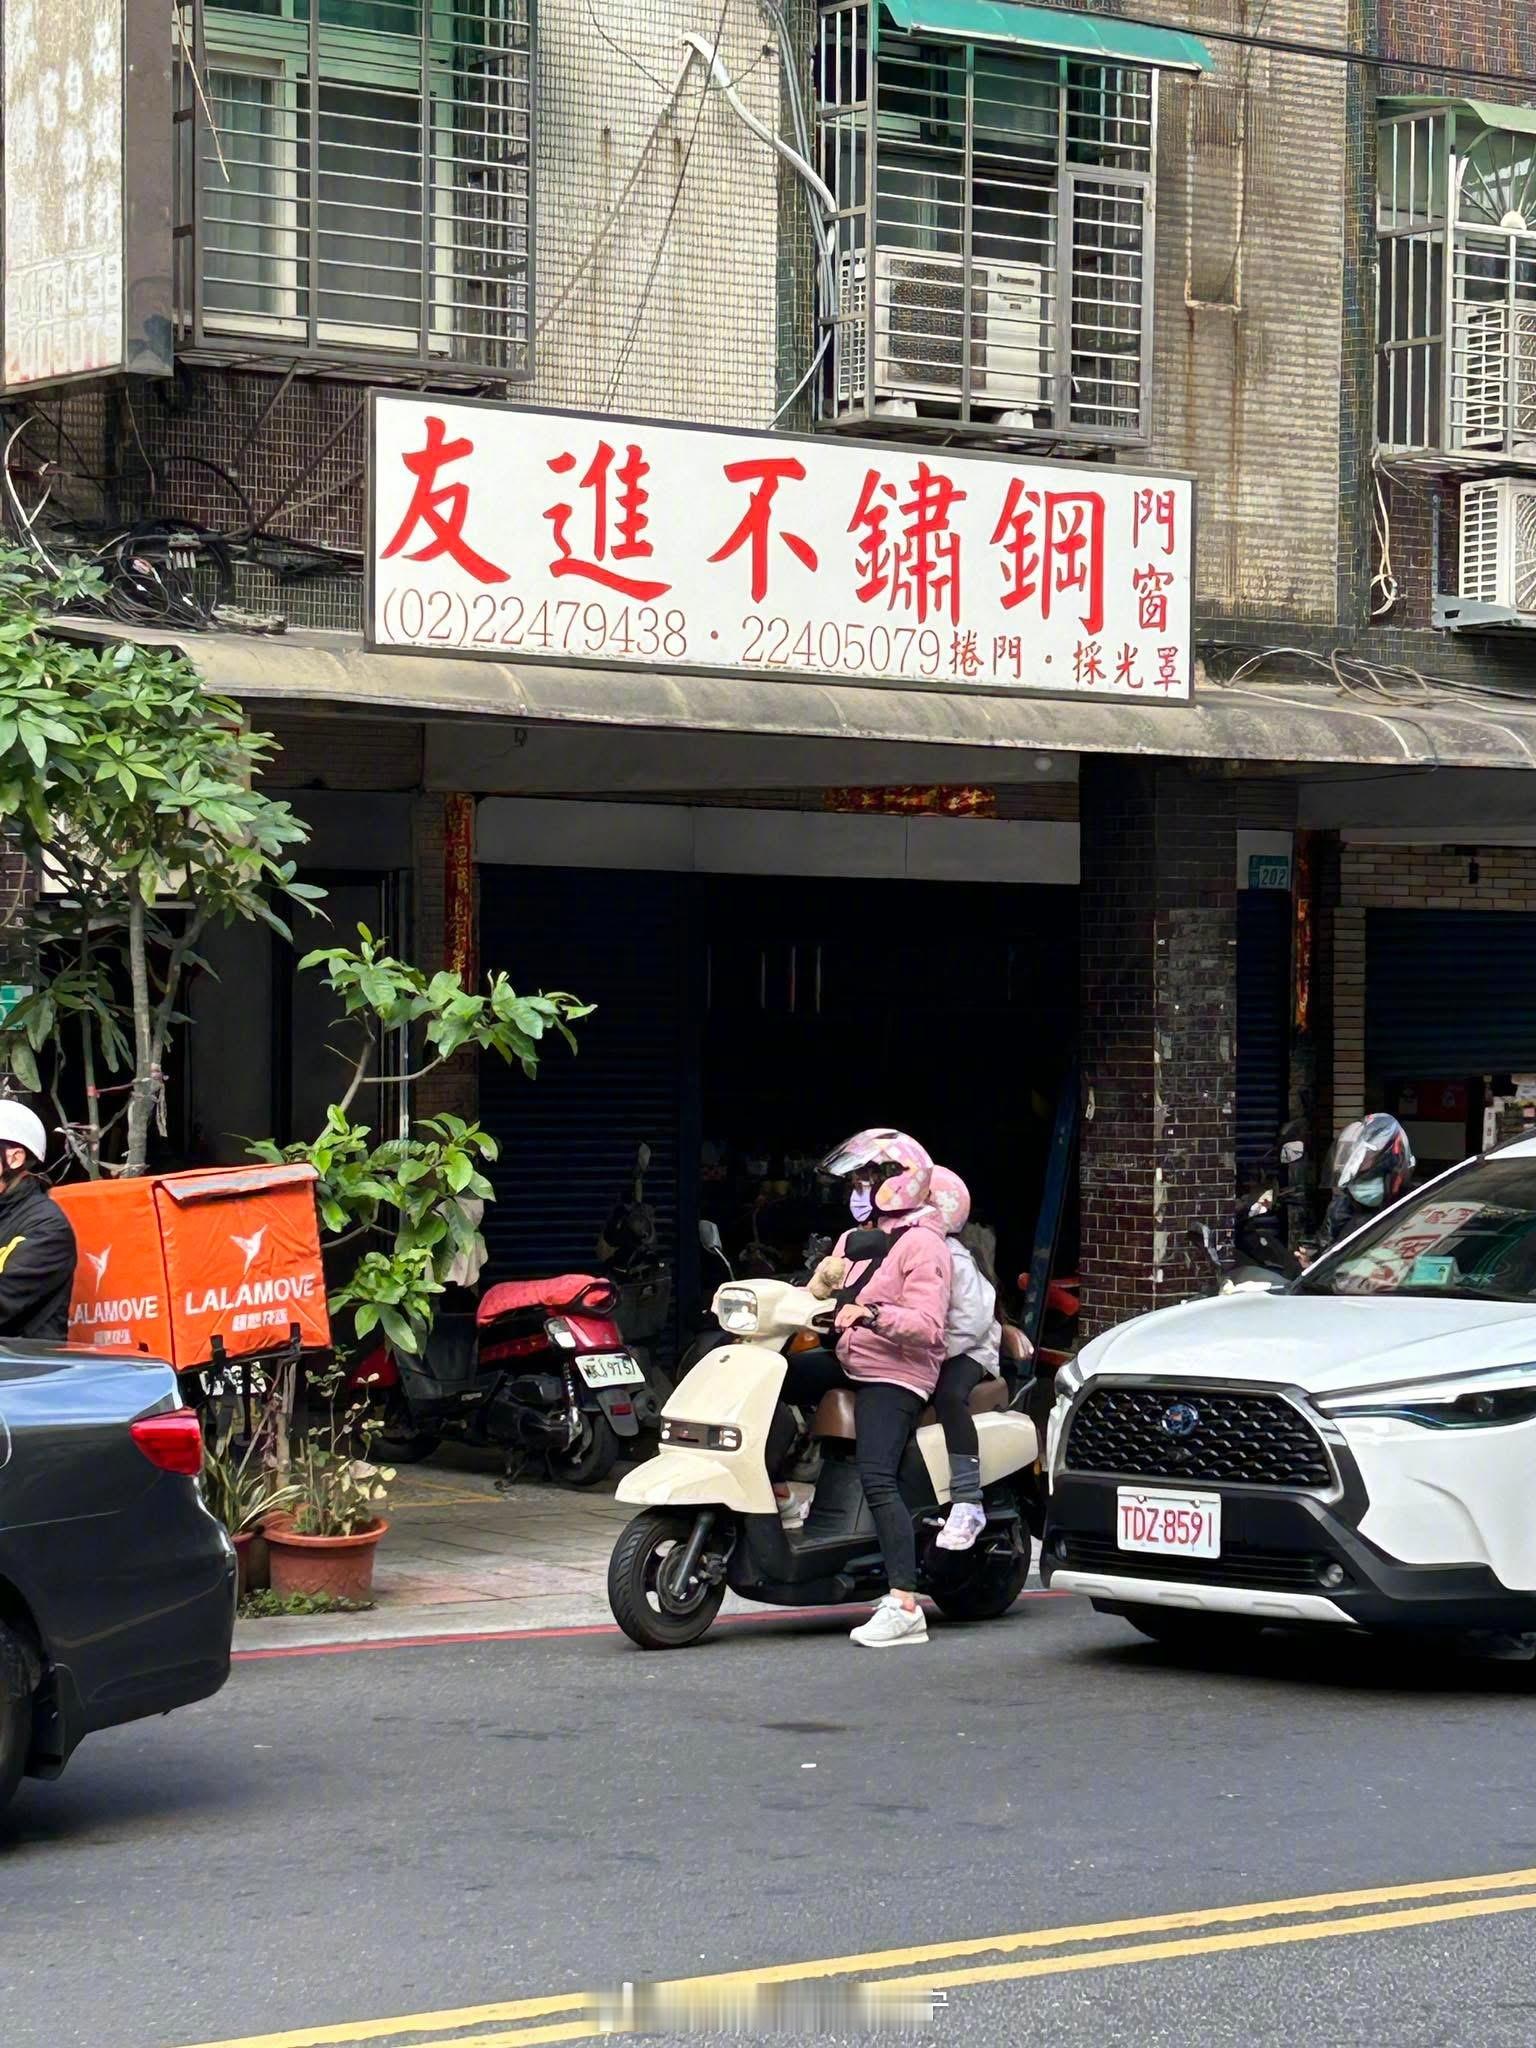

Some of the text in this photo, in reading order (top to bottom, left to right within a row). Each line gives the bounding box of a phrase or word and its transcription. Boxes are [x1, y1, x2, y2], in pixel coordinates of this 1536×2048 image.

[380, 415, 1105, 635] 友進不鏽鋼
[1132, 488, 1176, 633] 門窗
[384, 588, 687, 657] (02)22479438
[742, 615, 940, 675] 22405079
[1262, 868, 1285, 886] 202
[67, 1295, 159, 1327] ALAMOVE
[185, 1273, 316, 1315] LALAMOVE
[1120, 1505, 1212, 1548] TDZ-8591
